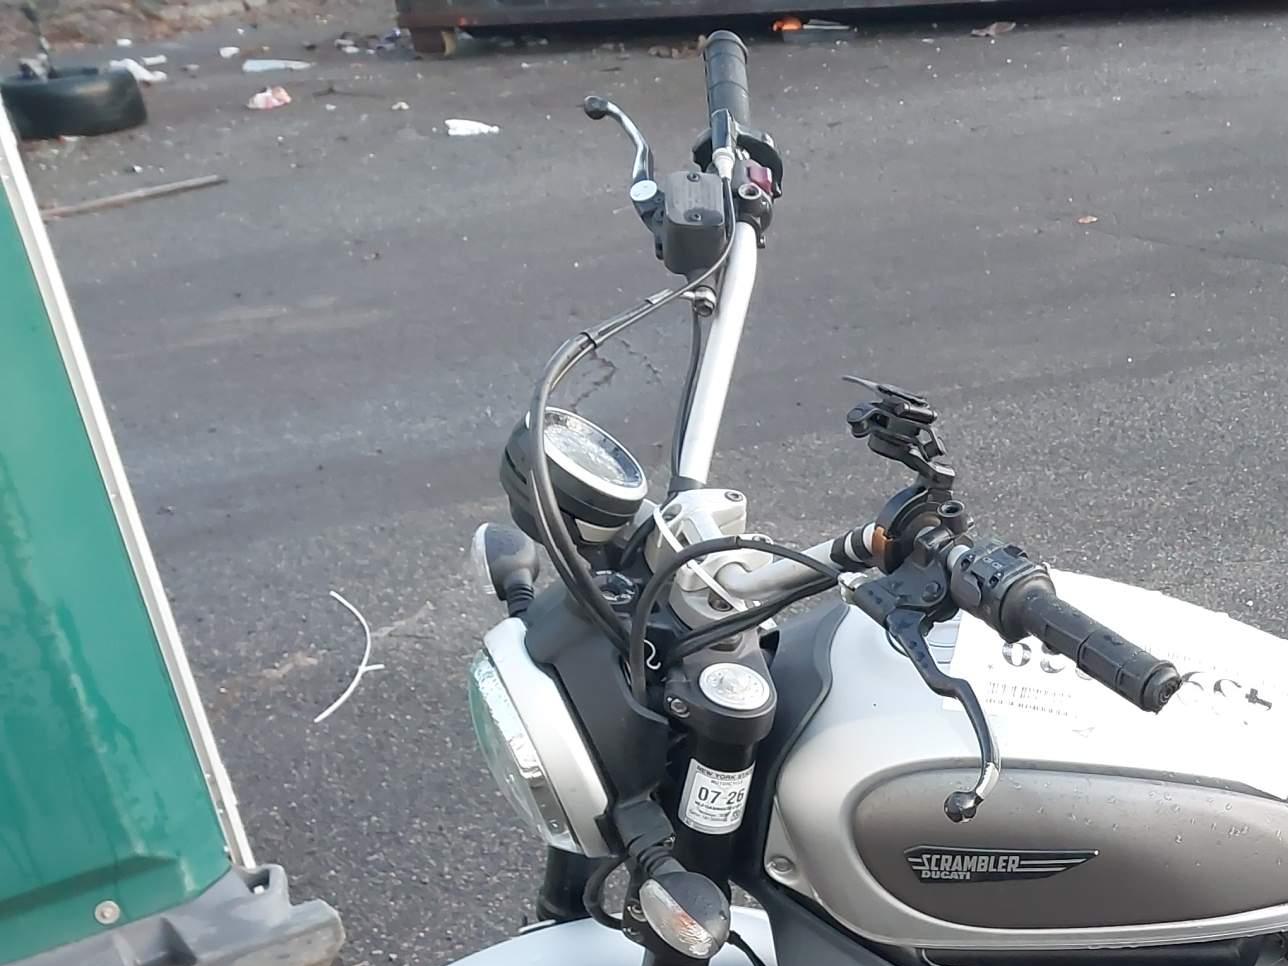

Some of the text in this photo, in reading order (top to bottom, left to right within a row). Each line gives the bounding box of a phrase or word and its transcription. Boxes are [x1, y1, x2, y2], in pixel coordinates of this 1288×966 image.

[698, 786, 745, 805] 07 26
[921, 854, 1020, 873] SCRAMBLER
[921, 870, 971, 880] DUCATI
